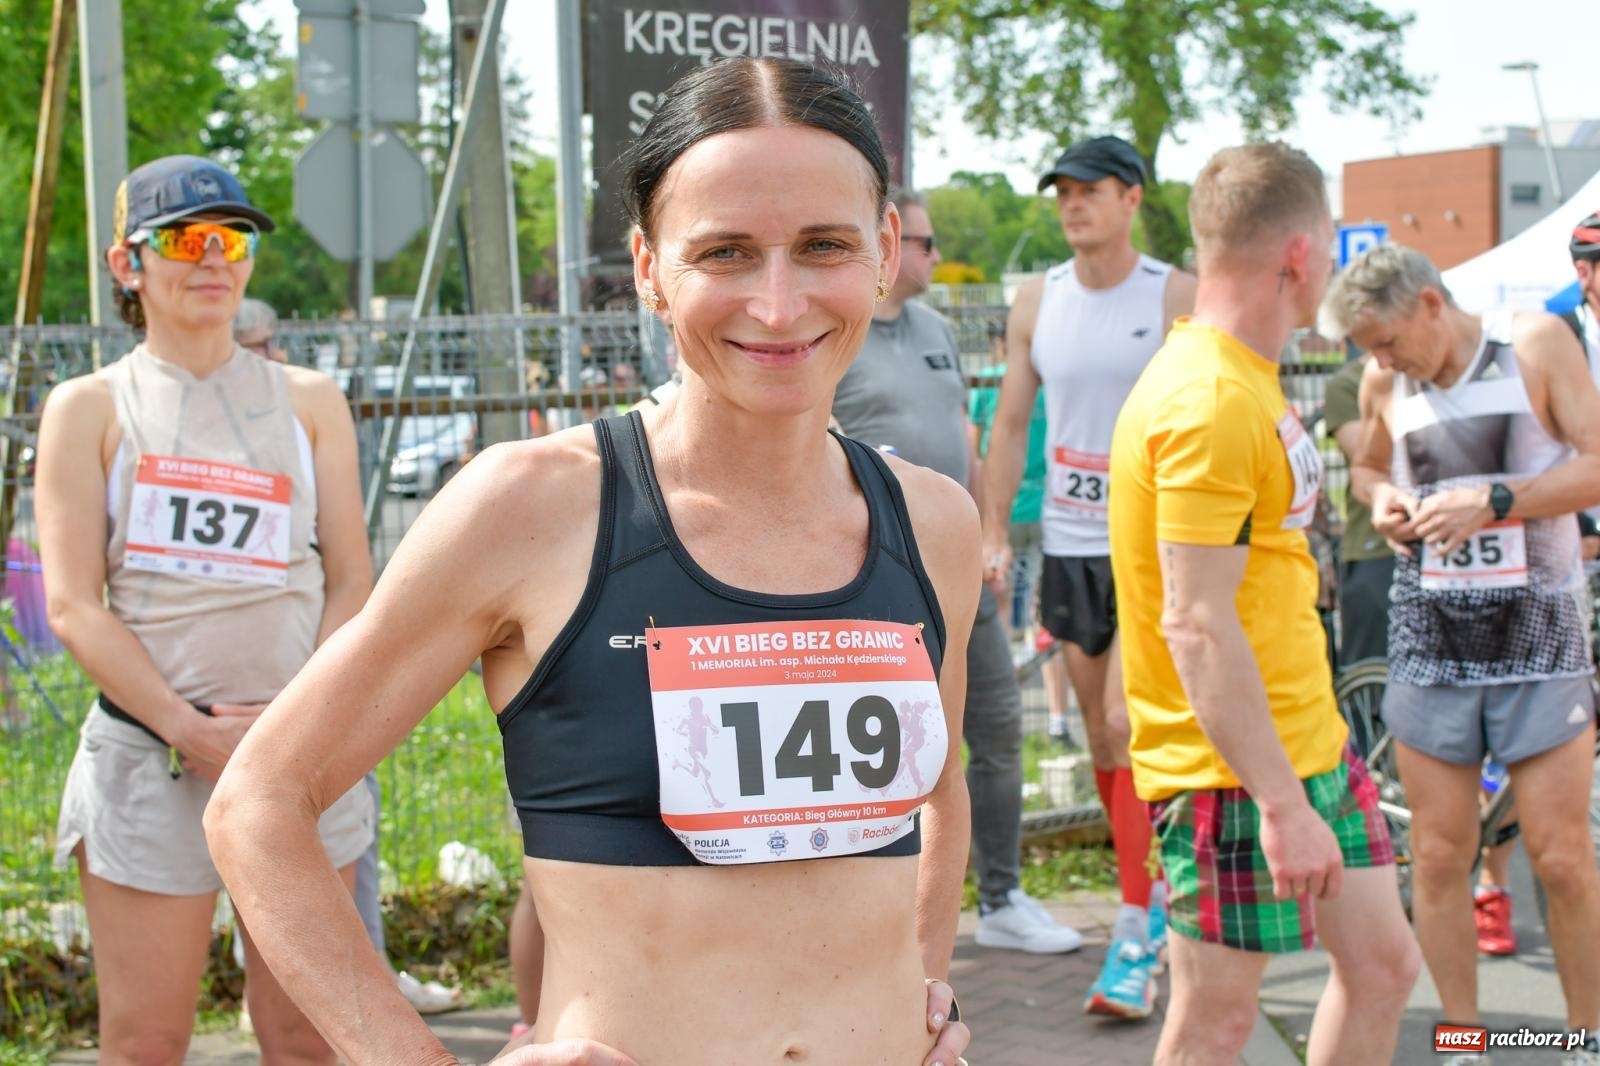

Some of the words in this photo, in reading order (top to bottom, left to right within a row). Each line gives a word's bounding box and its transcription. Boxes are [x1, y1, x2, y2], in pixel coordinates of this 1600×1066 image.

[623, 9, 880, 67] KRĘGIELNIA
[169, 495, 260, 549] 137
[687, 635, 731, 656] XVI
[734, 632, 788, 653] BIEG
[792, 631, 832, 650] BEZ
[835, 630, 904, 649] GRANIC
[760, 656, 778, 666] im.
[779, 657, 802, 668] asp.
[804, 654, 845, 665] Michała
[847, 654, 907, 666] Kędzierskiego
[784, 671, 790, 679] 3
[792, 671, 815, 680] maja
[816, 670, 837, 678] 2024
[720, 695, 901, 797] 149
[743, 812, 804, 825] KATEGORIA:
[805, 810, 826, 821] Bieg
[827, 807, 861, 820] Główny
[863, 807, 872, 815] 10
[873, 806, 887, 815] km
[862, 823, 901, 840] Racibór
[694, 839, 730, 848] POLICJA
